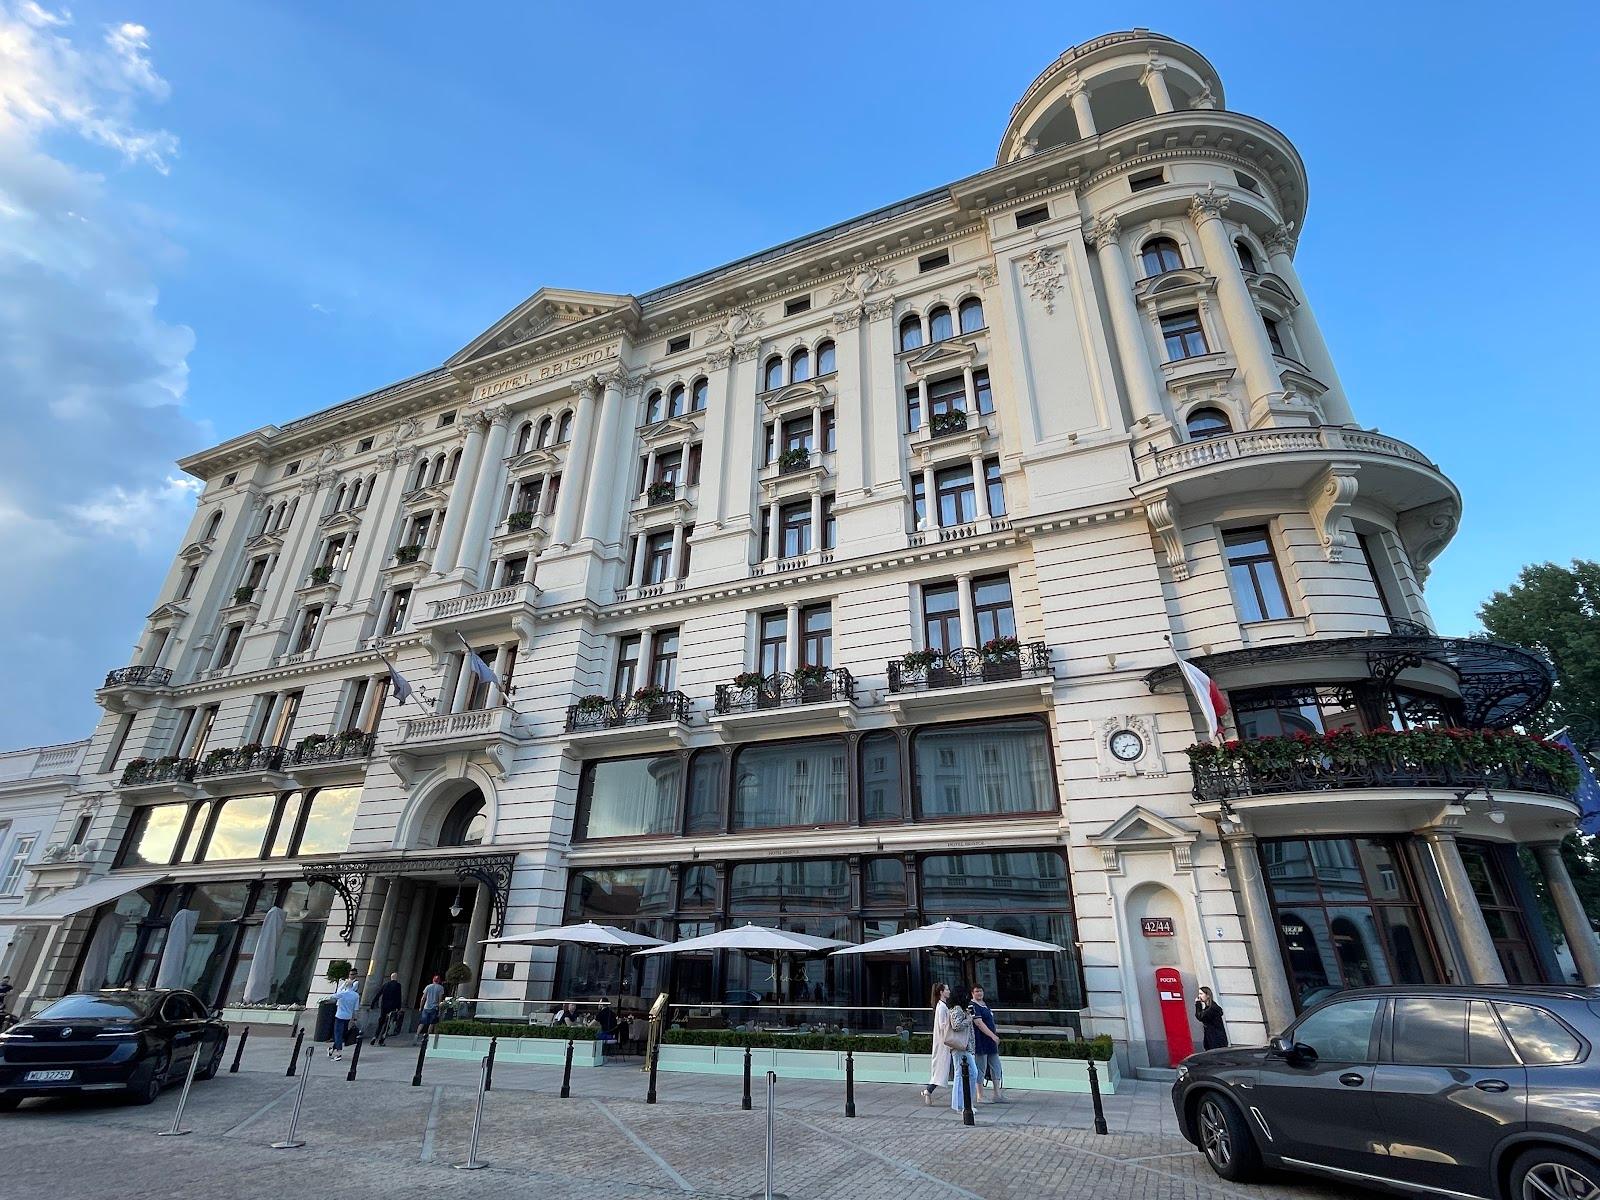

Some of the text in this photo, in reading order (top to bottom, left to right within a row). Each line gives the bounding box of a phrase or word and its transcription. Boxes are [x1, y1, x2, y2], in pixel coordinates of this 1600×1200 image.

[480, 344, 619, 399] HOTEL BRISTOL
[1144, 920, 1170, 932] 42/44
